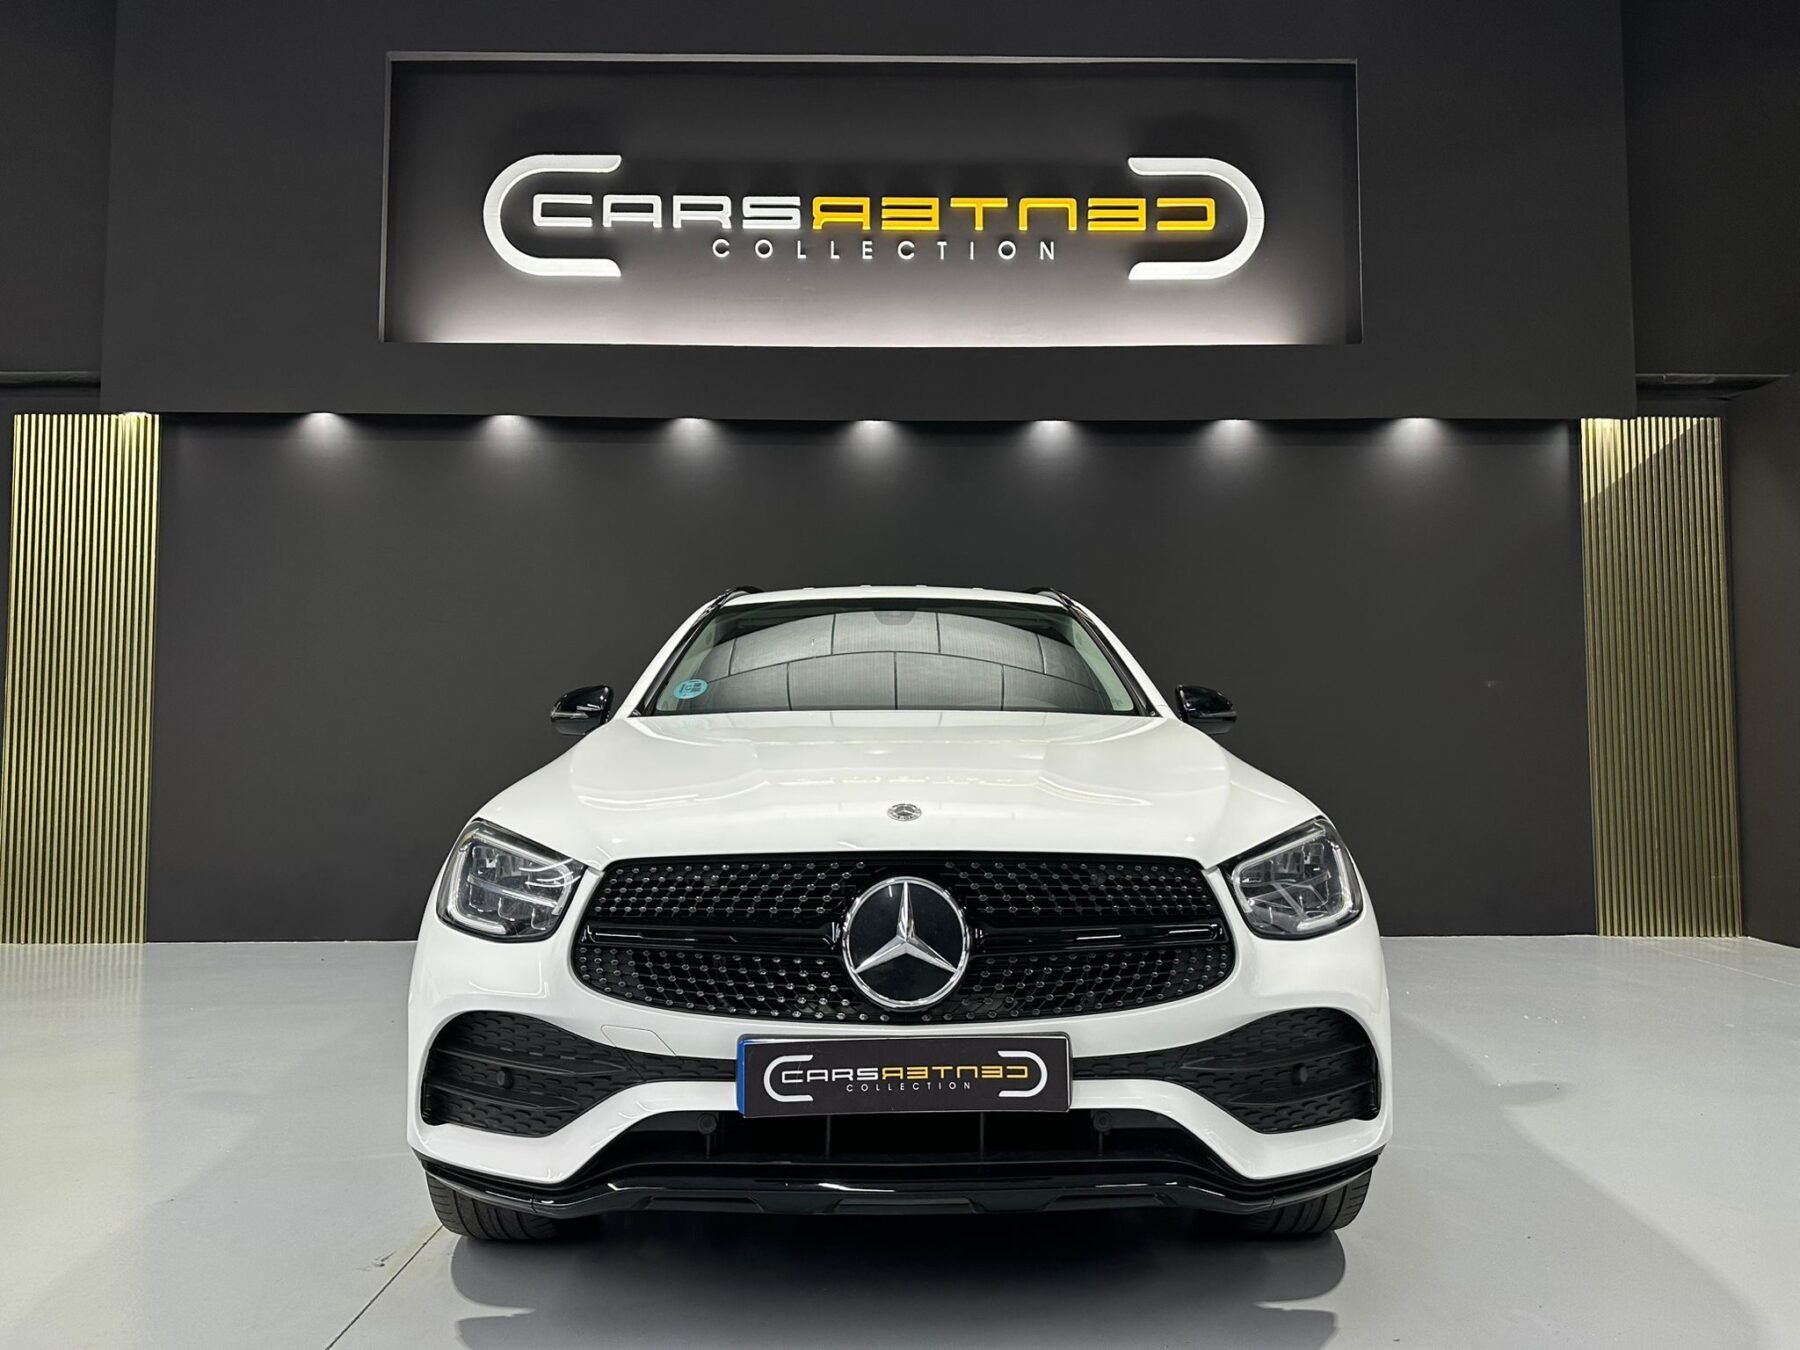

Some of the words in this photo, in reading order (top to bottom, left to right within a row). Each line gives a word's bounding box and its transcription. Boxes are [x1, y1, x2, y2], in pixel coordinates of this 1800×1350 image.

[532, 193, 801, 230] CARS
[712, 238, 1055, 260] COLLECTION
[781, 1067, 879, 1083] CARS
[846, 1081, 971, 1092] COLLECTION
